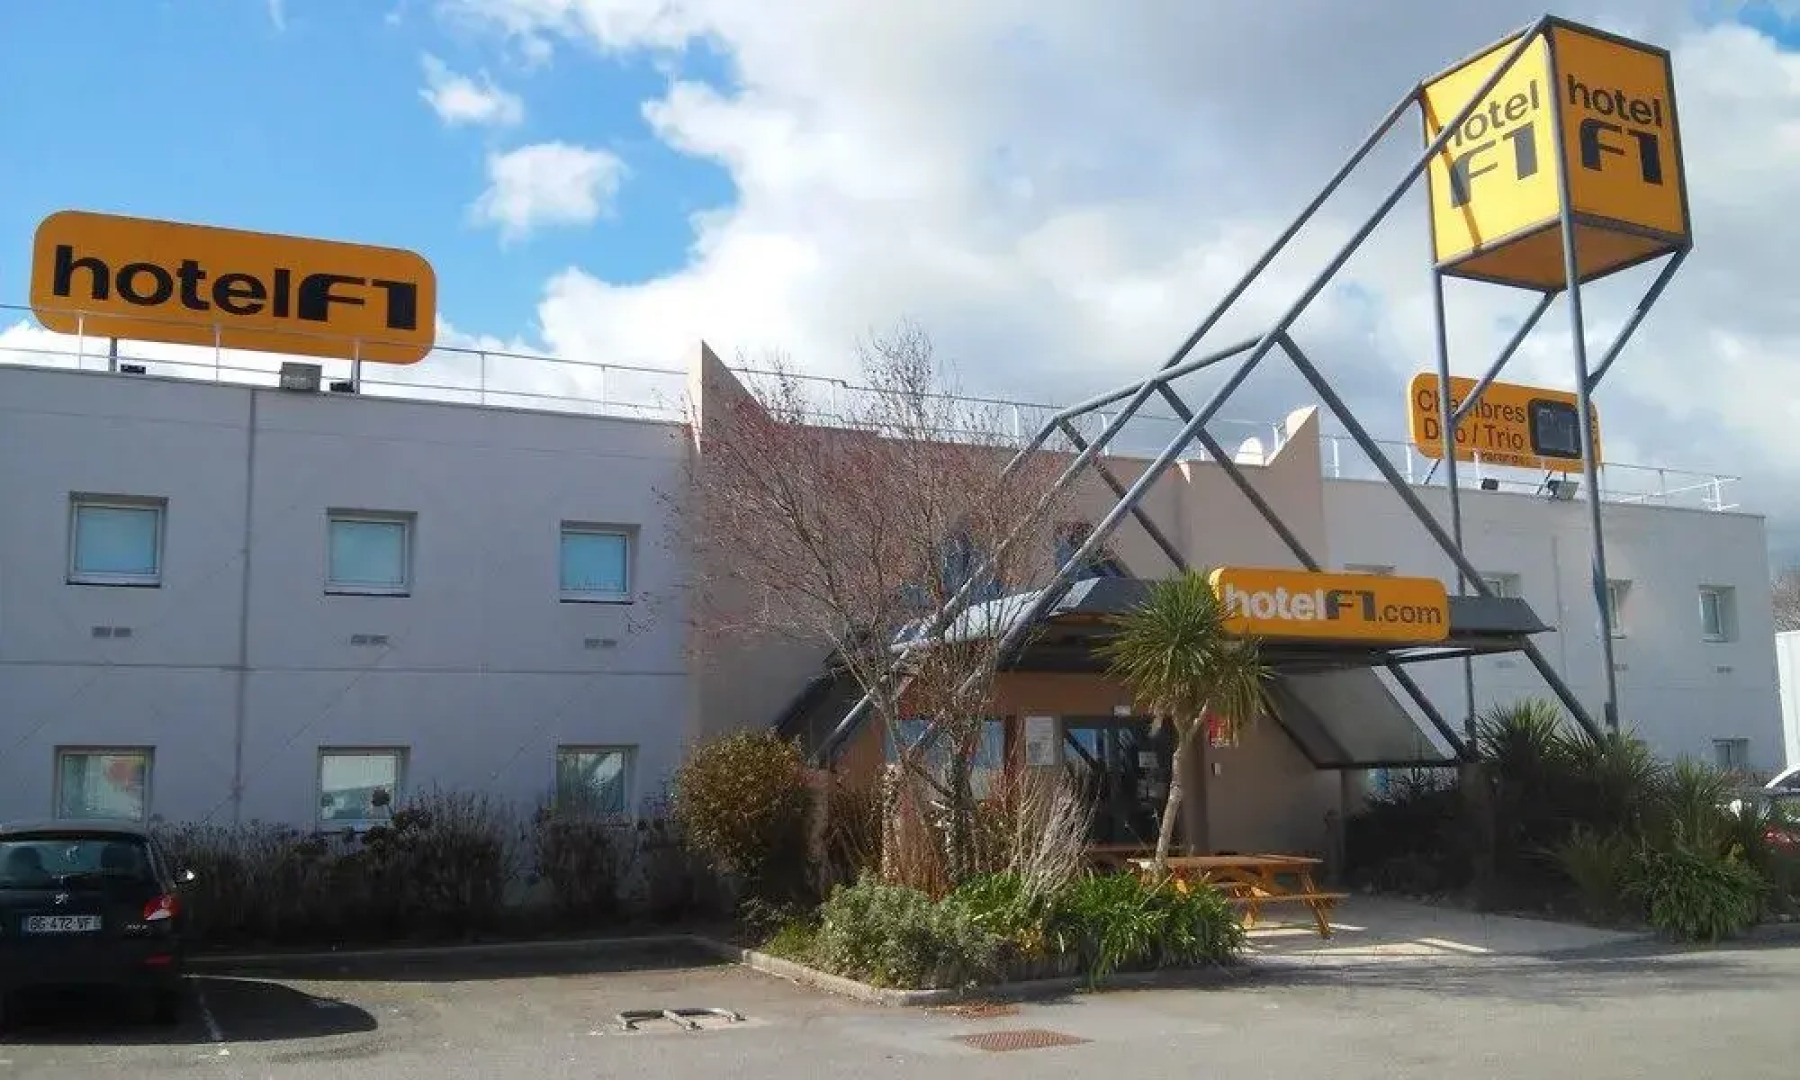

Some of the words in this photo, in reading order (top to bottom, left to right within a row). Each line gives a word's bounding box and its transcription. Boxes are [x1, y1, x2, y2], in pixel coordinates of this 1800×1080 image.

[1567, 74, 1663, 127] hotel
[1452, 121, 1538, 207] F1
[1580, 118, 1663, 186] F1
[53, 244, 417, 331] hotelF1
[1424, 418, 1466, 443] Do
[1485, 424, 1524, 450] Trio
[1223, 583, 1441, 624] hotelF1.com
